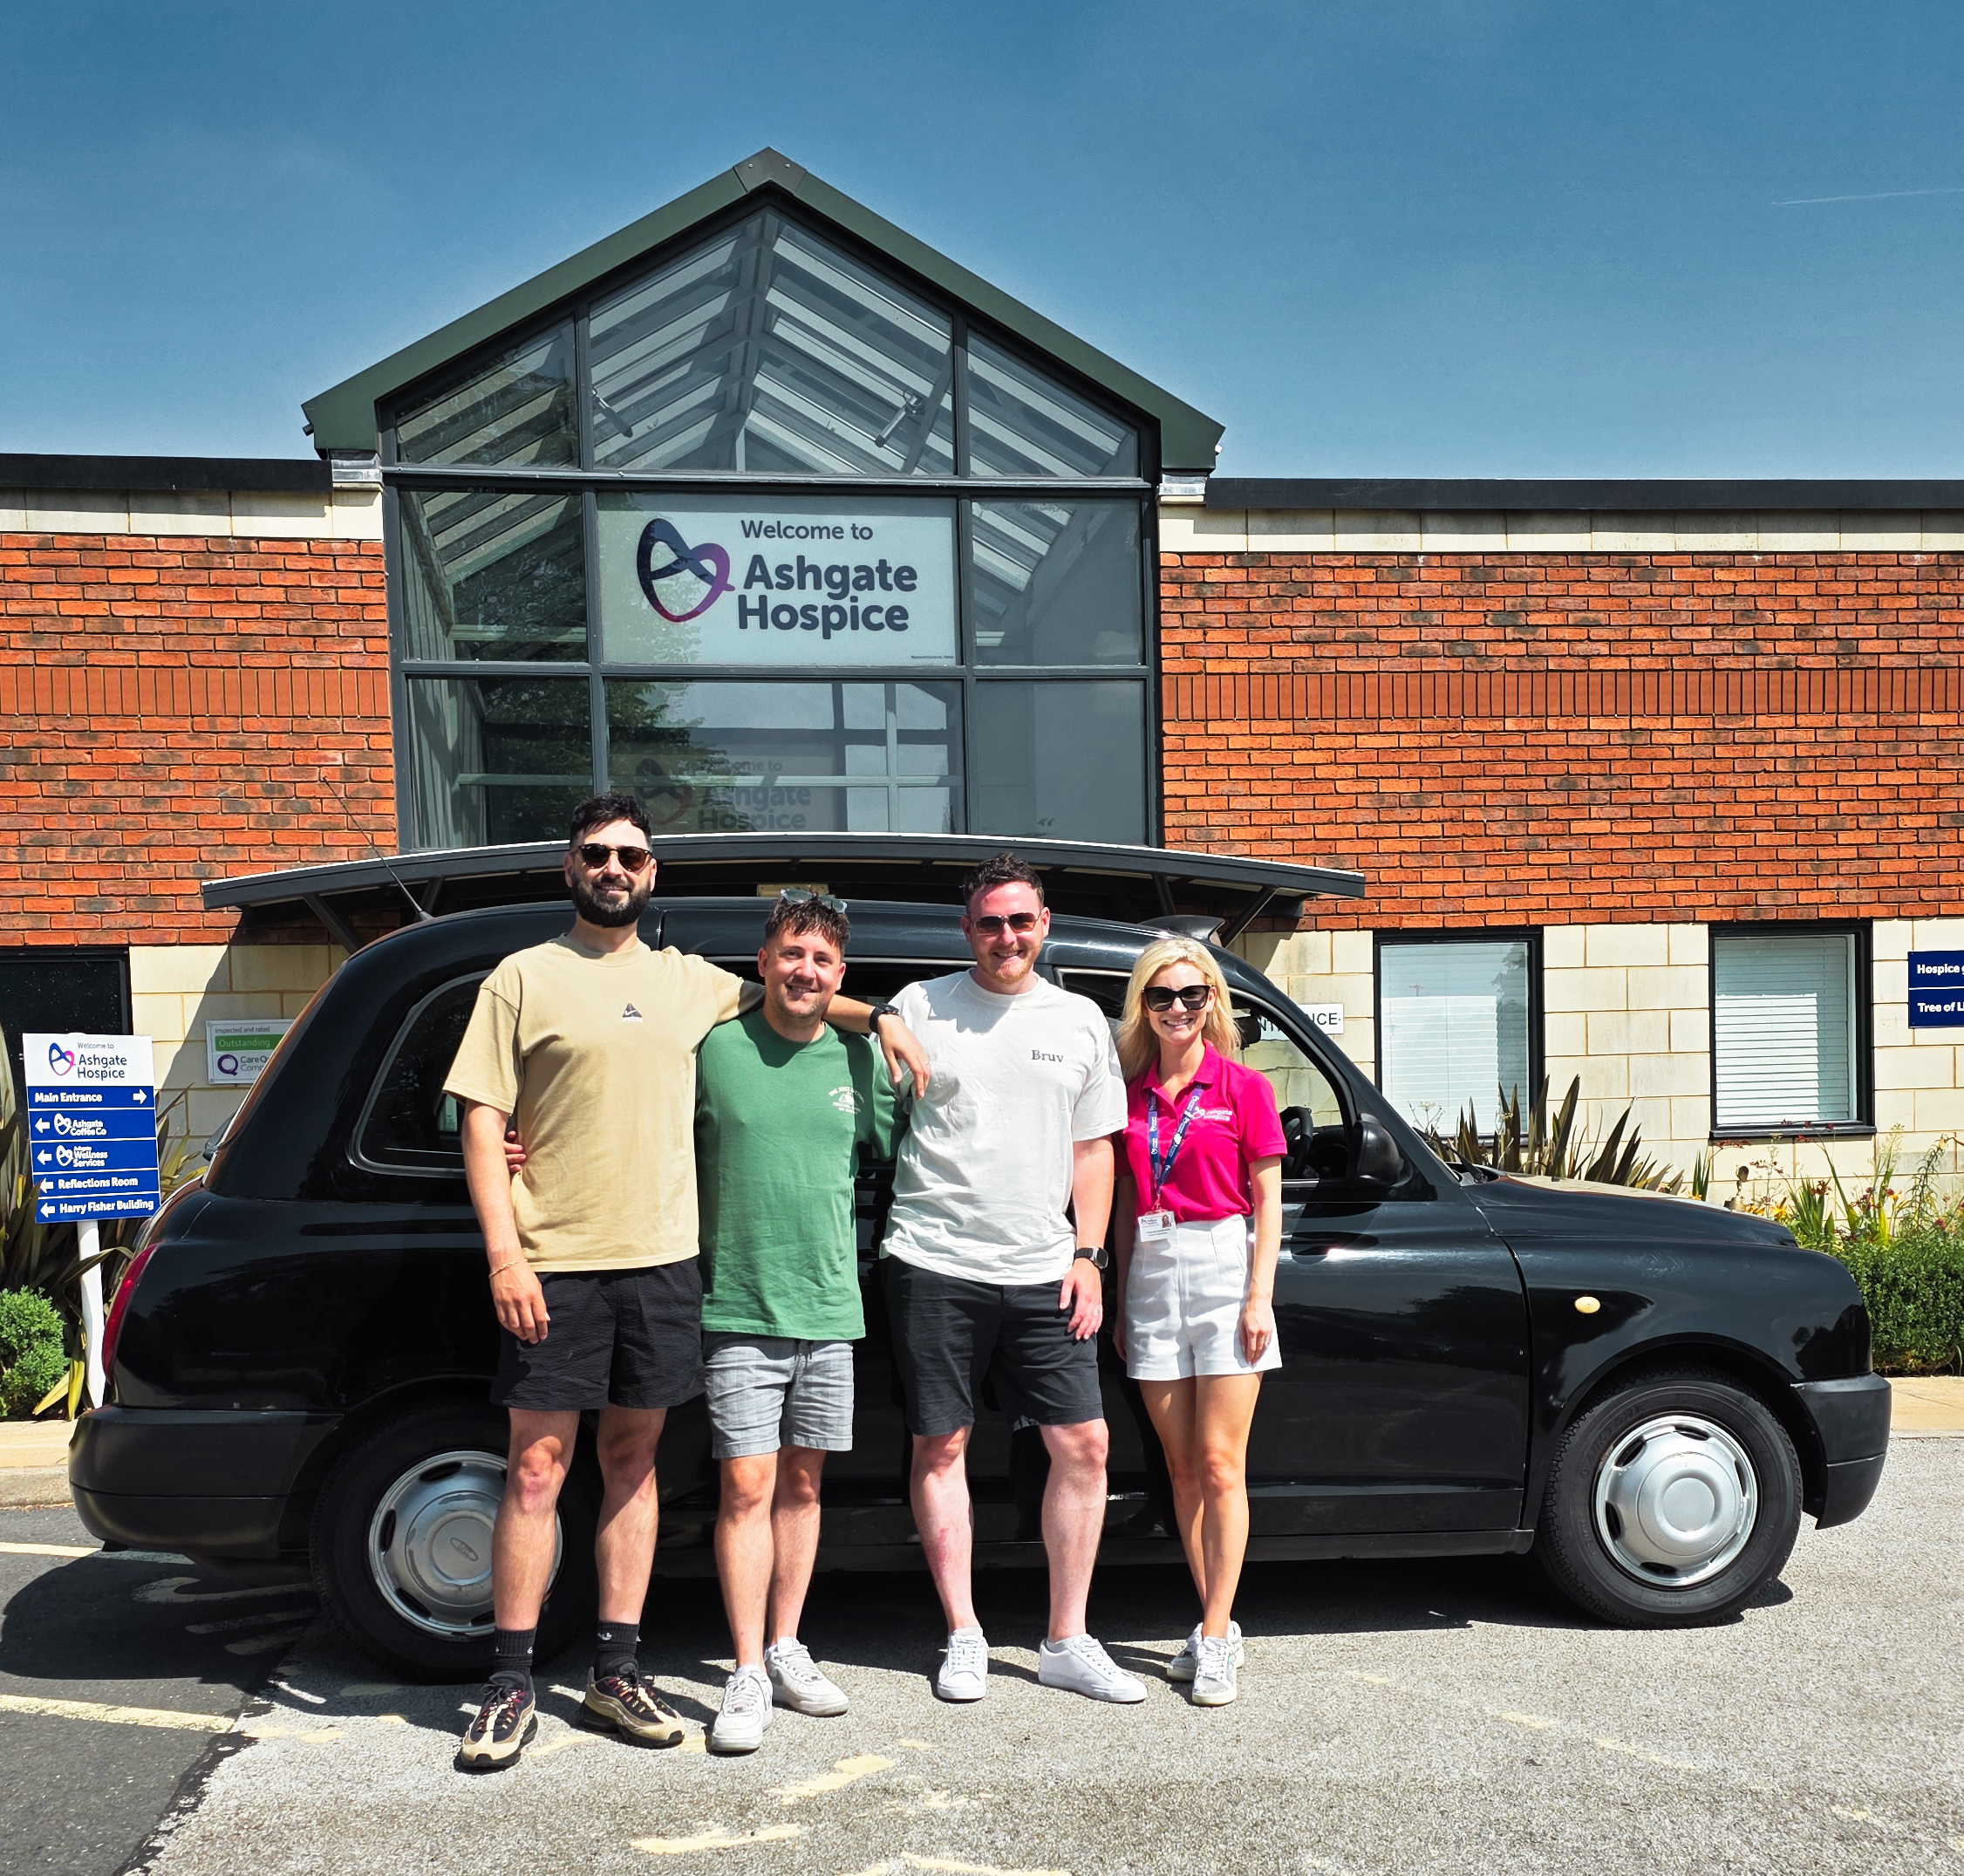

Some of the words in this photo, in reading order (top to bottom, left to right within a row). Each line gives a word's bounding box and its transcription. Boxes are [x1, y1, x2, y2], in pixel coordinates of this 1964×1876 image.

[740, 520, 844, 540] Welcome
[851, 523, 874, 540] to
[744, 554, 917, 601] Ashgate
[738, 594, 910, 639] Hospice
[1917, 964, 1961, 975] Hospice
[1917, 1003, 1941, 1013] Tree
[1943, 1001, 1955, 1012] of
[219, 1038, 270, 1048] Outstanding
[78, 1054, 127, 1068] Ashgate
[1031, 1049, 1064, 1063] Bruv
[77, 1067, 126, 1081] Hospice
[35, 1092, 58, 1102] Main
[60, 1092, 103, 1102] Entrance
[73, 1150, 108, 1159] Wellness
[72, 1158, 106, 1167] Services
[58, 1178, 111, 1190] Reflections
[111, 1177, 139, 1187] Room
[59, 1204, 87, 1215] Harry
[87, 1201, 116, 1212] Fisher
[116, 1198, 154, 1211] Building
